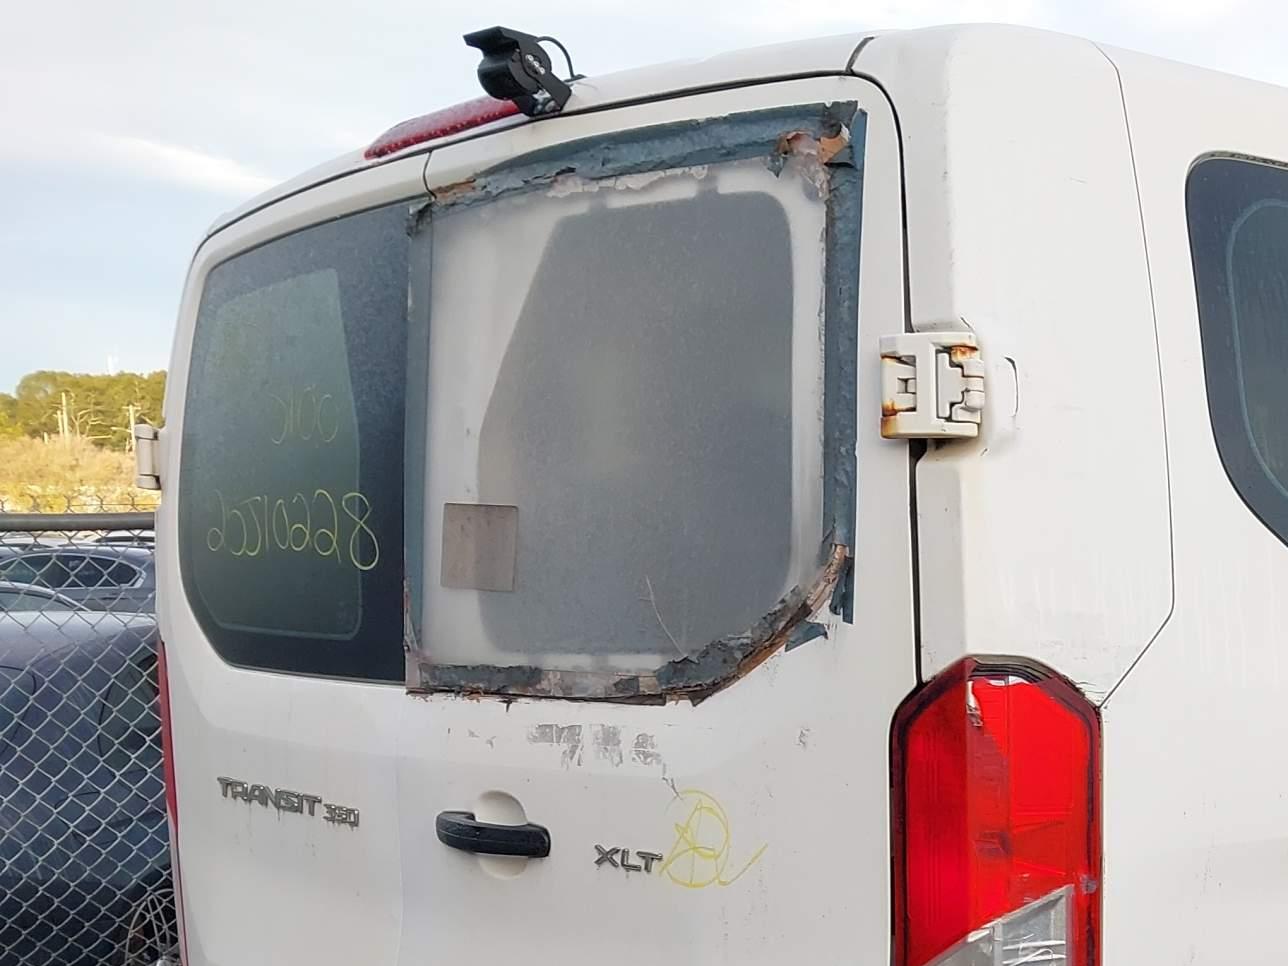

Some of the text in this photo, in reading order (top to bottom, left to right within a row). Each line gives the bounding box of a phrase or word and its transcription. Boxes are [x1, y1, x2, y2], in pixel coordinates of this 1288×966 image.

[217, 776, 360, 826] TRANSIT 350
[594, 844, 663, 873] XLT
